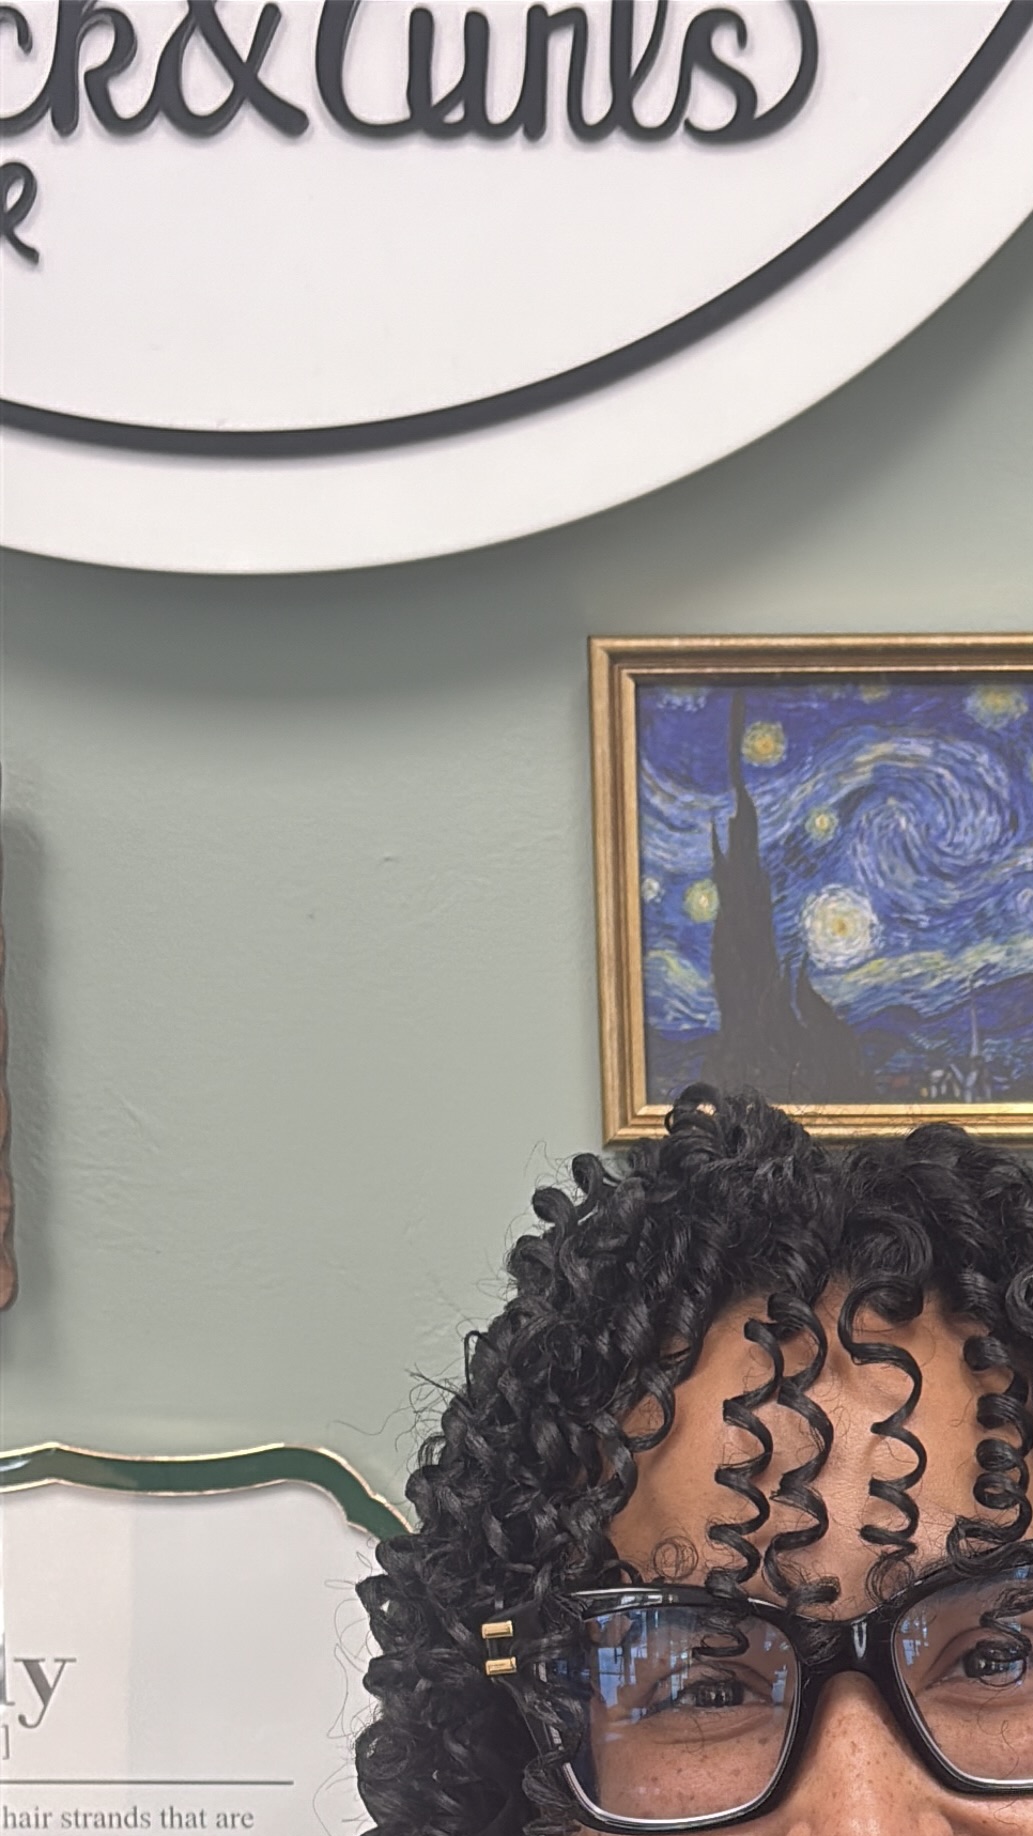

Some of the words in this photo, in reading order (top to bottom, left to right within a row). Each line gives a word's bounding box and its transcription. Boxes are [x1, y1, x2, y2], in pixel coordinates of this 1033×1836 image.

[2, 1804, 53, 1830] hair
[60, 1804, 152, 1830] strands
[160, 1804, 208, 1830] that
[215, 1810, 255, 1830] are
